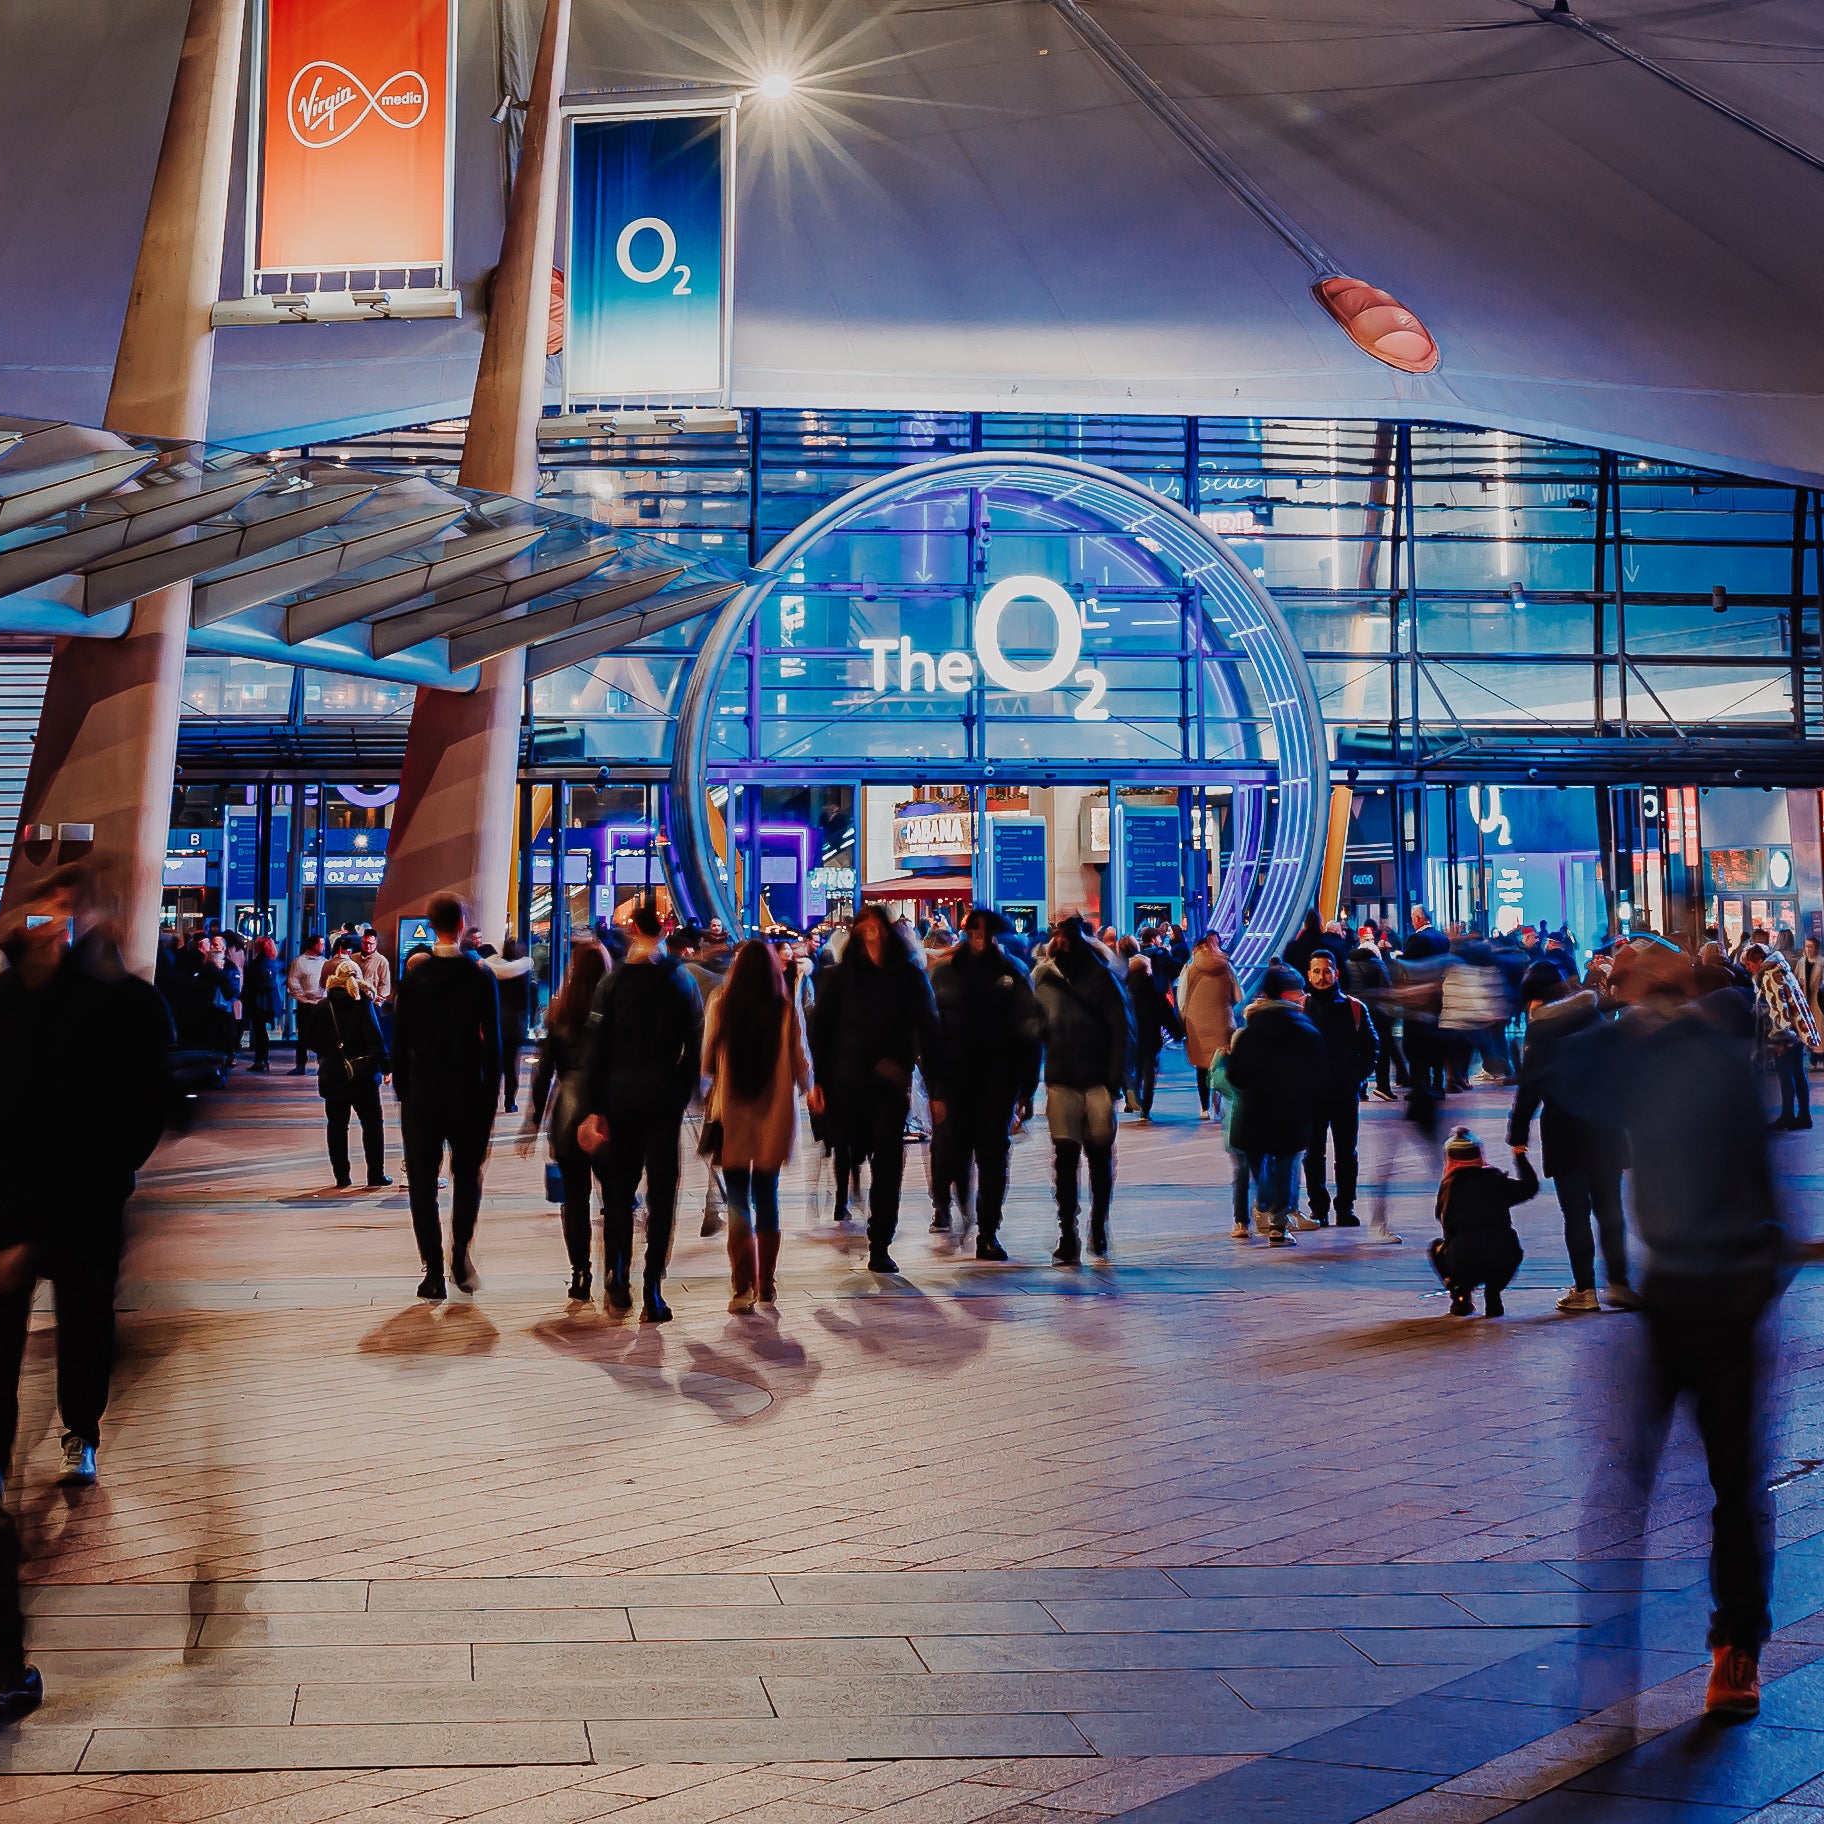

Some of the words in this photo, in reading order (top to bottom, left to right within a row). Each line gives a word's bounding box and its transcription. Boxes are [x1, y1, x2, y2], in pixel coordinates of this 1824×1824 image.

[297, 76, 358, 132] Virgin
[381, 90, 422, 107] media
[615, 216, 692, 296] O2
[858, 635, 973, 693] The
[974, 574, 1110, 721] O2
